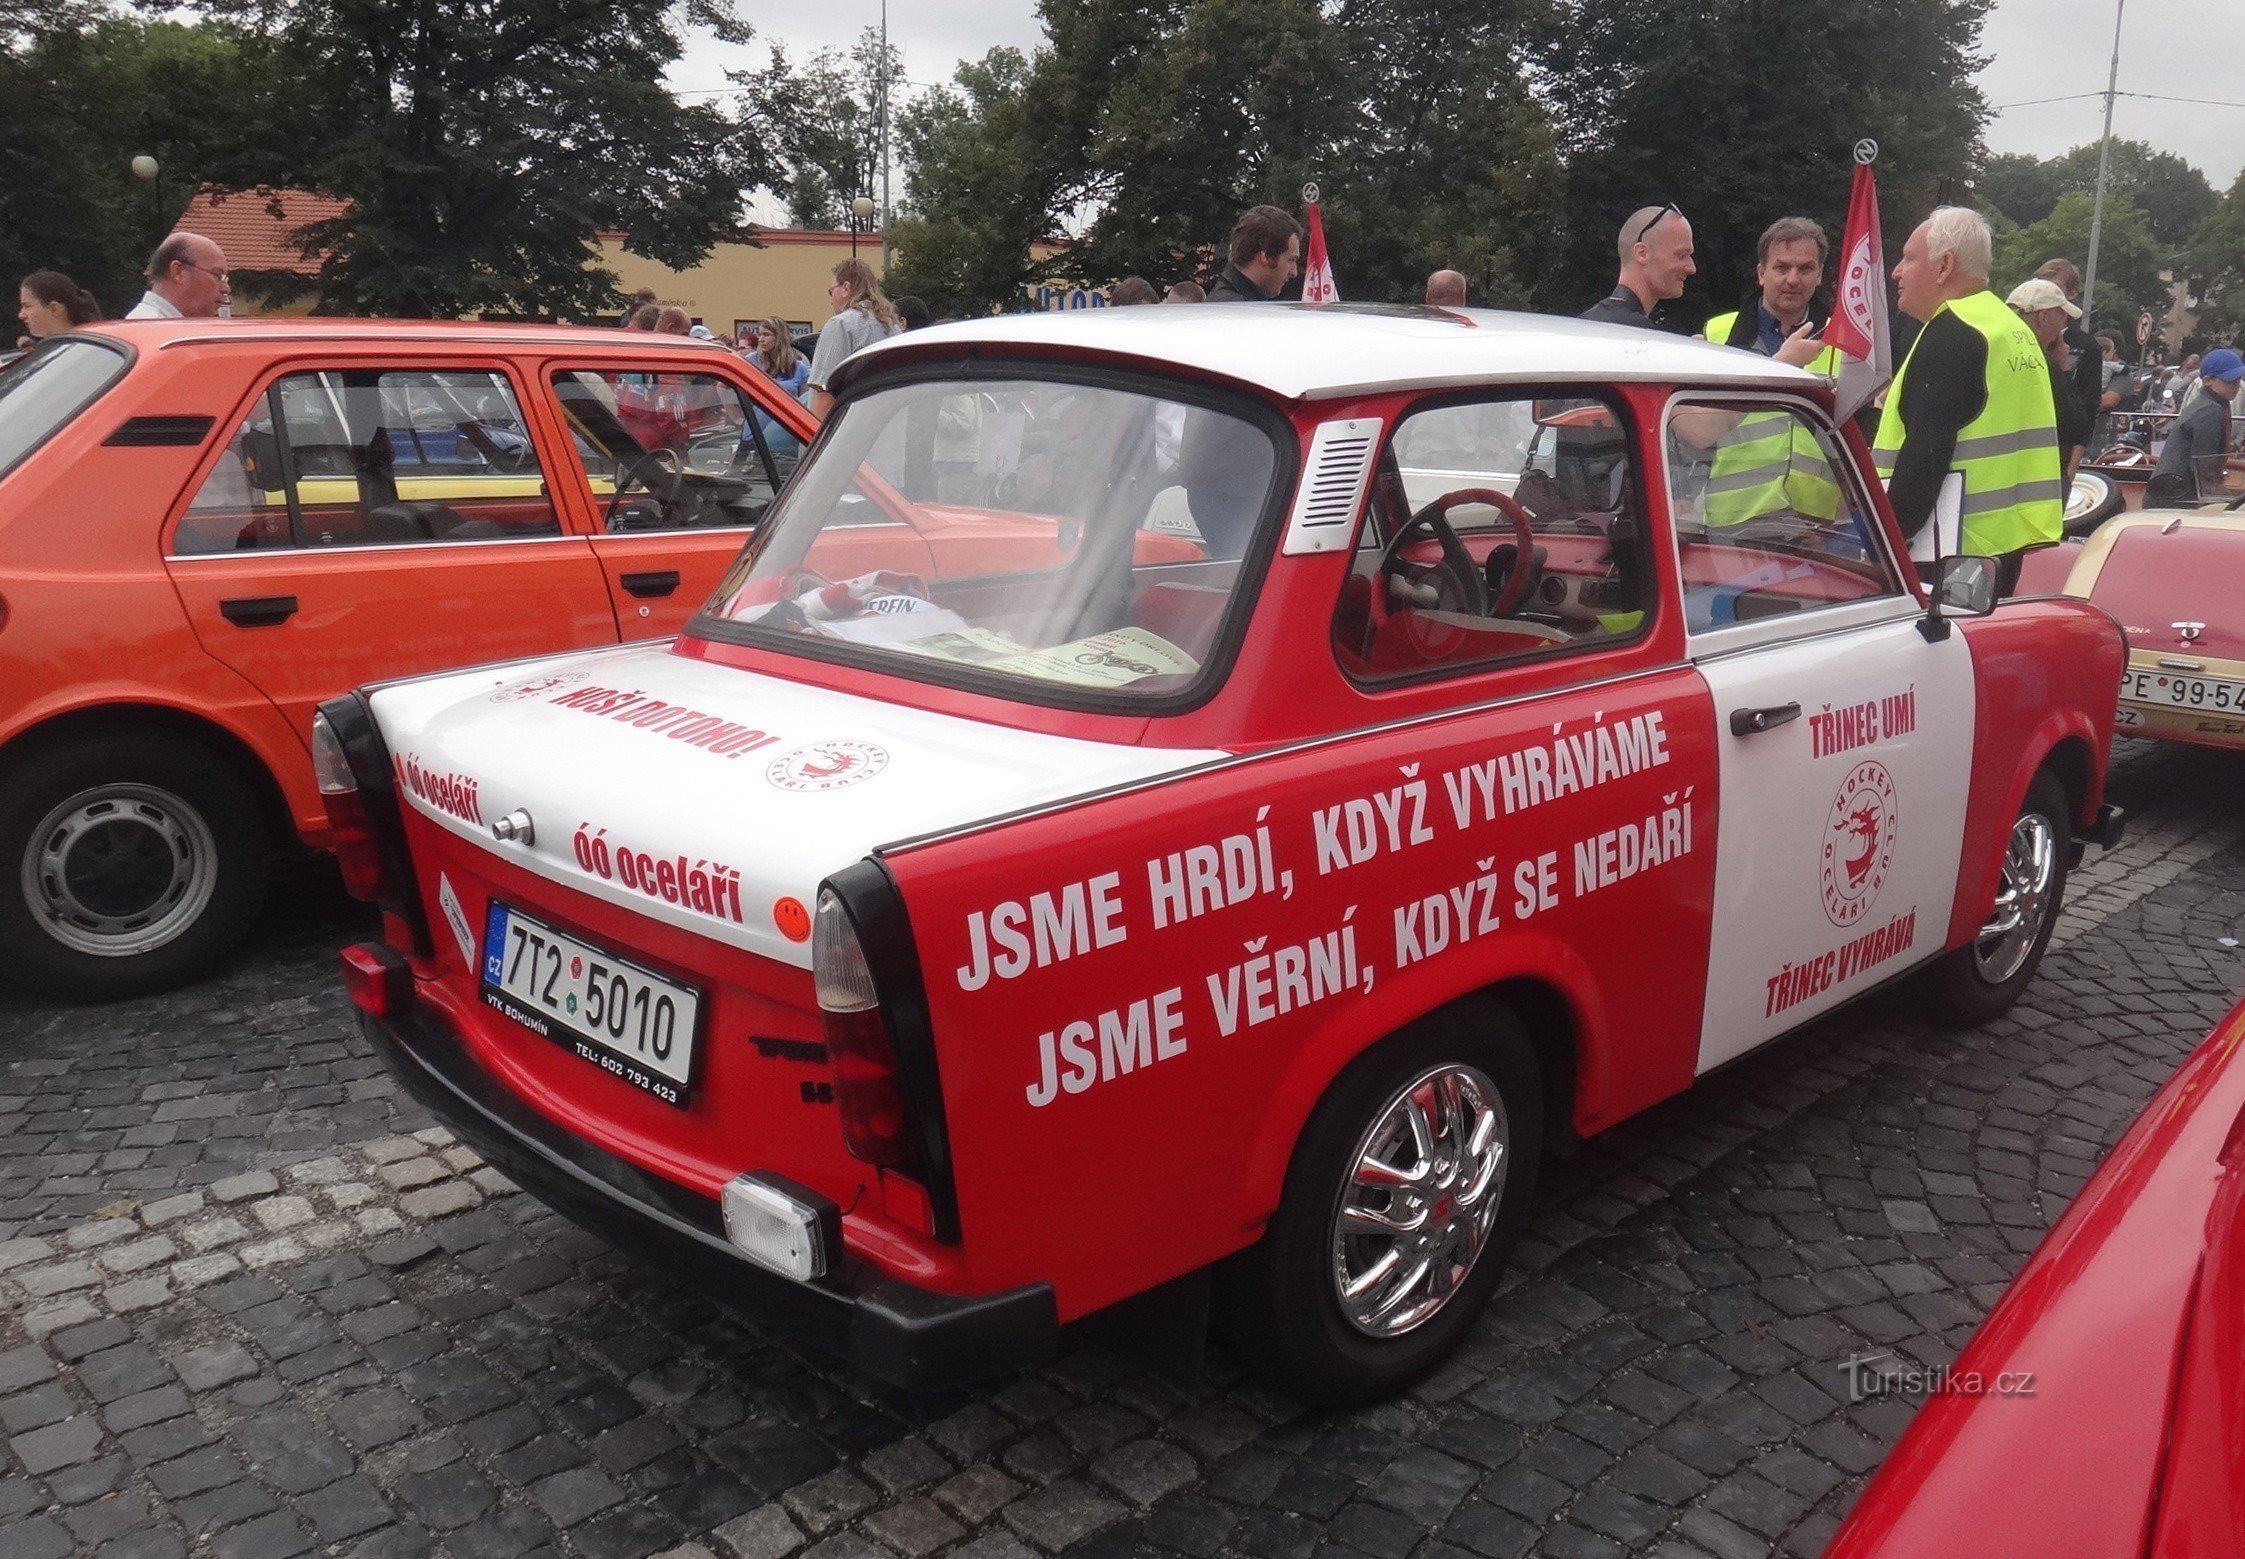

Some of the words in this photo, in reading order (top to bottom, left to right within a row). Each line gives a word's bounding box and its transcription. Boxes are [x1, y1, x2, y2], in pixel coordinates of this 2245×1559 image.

[548, 686, 642, 716] HOŠI
[612, 700, 782, 759] DOTOHO!
[1809, 700, 1878, 760] TŘINEC
[1881, 683, 1916, 738] UMÍ
[422, 772, 484, 827] oceláři
[1837, 766, 1892, 812] HOCKEY
[573, 822, 613, 880] óó
[615, 855, 744, 925] oceláři
[956, 870, 1127, 992] JSME
[1146, 805, 1294, 930] HRDÍ,
[1312, 762, 1434, 876] KDYŽ
[1443, 710, 1670, 831] VYHRÁVÁME
[1873, 814, 1895, 890] CLUB
[488, 955, 501, 977] CZ
[1026, 986, 1188, 1108] JSME
[1206, 905, 1374, 1038] VĚRNÍ,
[1393, 855, 1500, 969] KDYŽ
[1513, 850, 1560, 921] SE
[1573, 785, 1695, 898] NEDAŘÍ
[1765, 950, 1836, 1019] TŘINEC
[1837, 905, 1917, 983] VYHRÁVÁ
[487, 993, 503, 1012] VTK
[504, 1003, 549, 1037] BOHUMÍN
[507, 925, 563, 1010] 7T2
[585, 961, 676, 1062] 5010
[575, 1042, 599, 1063] TEL:
[600, 1055, 624, 1076] 602
[626, 1068, 650, 1090] 793
[652, 1083, 678, 1104] 423
